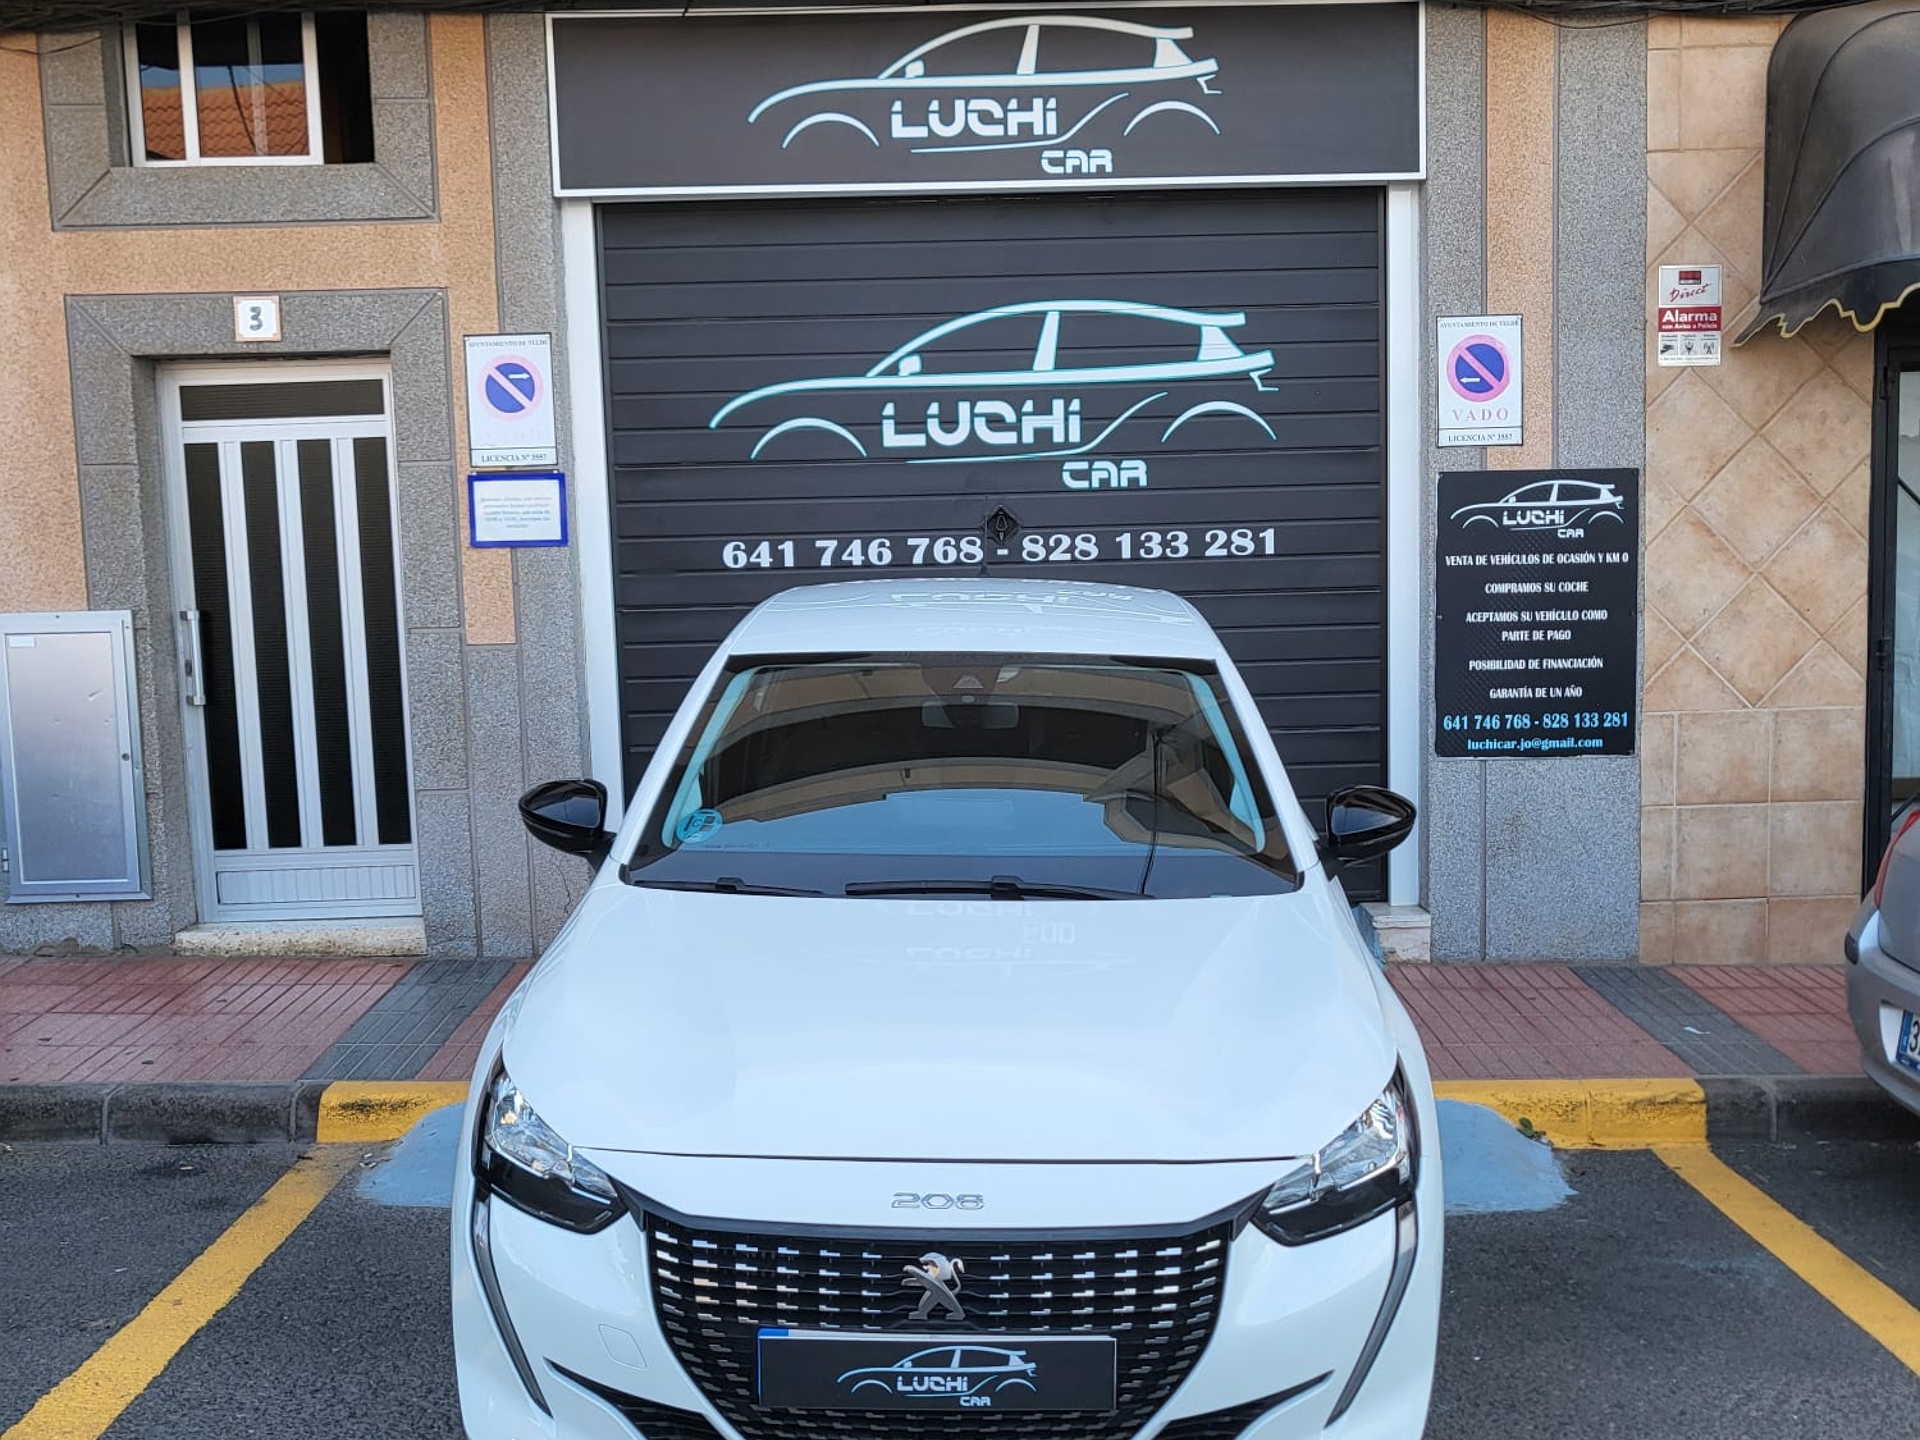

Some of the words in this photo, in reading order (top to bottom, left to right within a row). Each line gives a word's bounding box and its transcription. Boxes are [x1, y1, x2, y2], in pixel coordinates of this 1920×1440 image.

[891, 97, 1058, 139] LUCHI
[1041, 149, 1113, 174] CAR
[249, 306, 263, 331] 3
[1662, 310, 1717, 322] Alarma
[1453, 408, 1509, 421] VADO
[881, 398, 1082, 448] LUCHI
[1448, 432, 1485, 442] LICENCIA
[481, 453, 520, 463] LICENCIA
[1062, 459, 1148, 489] CAR
[1502, 509, 1565, 526] LUCHI
[1557, 528, 1585, 539] CAR
[722, 541, 795, 569] 641
[815, 538, 893, 567] 746
[906, 536, 984, 565] 768
[1022, 533, 1099, 562] 828
[1115, 531, 1189, 559] 133
[1204, 528, 1276, 557] 281
[1445, 555, 1474, 567] VENTA
[1476, 554, 1488, 566] DE
[1490, 552, 1541, 566] VEHÍCULOS
[1542, 554, 1555, 565] DE
[1557, 551, 1596, 565] OCASIÓN
[1598, 553, 1605, 564] Y
[1605, 552, 1620, 564] KM
[1485, 582, 1542, 594] COMPRAMOS
[1544, 582, 1556, 593] SU
[1558, 581, 1589, 593] COCHE
[1466, 611, 1519, 623] ACEPTAMOS
[1520, 611, 1533, 622] SU
[1535, 609, 1579, 622] VEHÍCULO
[1581, 609, 1608, 621] COMO
[1502, 630, 1531, 641] PARTE
[1532, 630, 1545, 641] DE
[1547, 629, 1572, 641] PAGO
[1469, 659, 1527, 671] POSIBILIDAD
[1528, 658, 1541, 670] DE
[1543, 655, 1604, 670] FINANCIACIÓN
[1489, 685, 1533, 699] GARANTÍA
[1535, 687, 1548, 698] DE
[1550, 687, 1563, 698] UN
[1564, 684, 1583, 698] AÑO
[1443, 715, 1468, 731] 641
[1474, 714, 1501, 730] 746
[1505, 713, 1531, 730] 768
[1542, 712, 1569, 729] 828
[1573, 712, 1600, 728] 133
[1603, 711, 1628, 728] 281
[1467, 737, 1604, 752] luchicar.jo@gmail.com
[891, 1192, 984, 1211] 208
[896, 1375, 968, 1393] LUCHI
[959, 1395, 992, 1408] CAR
